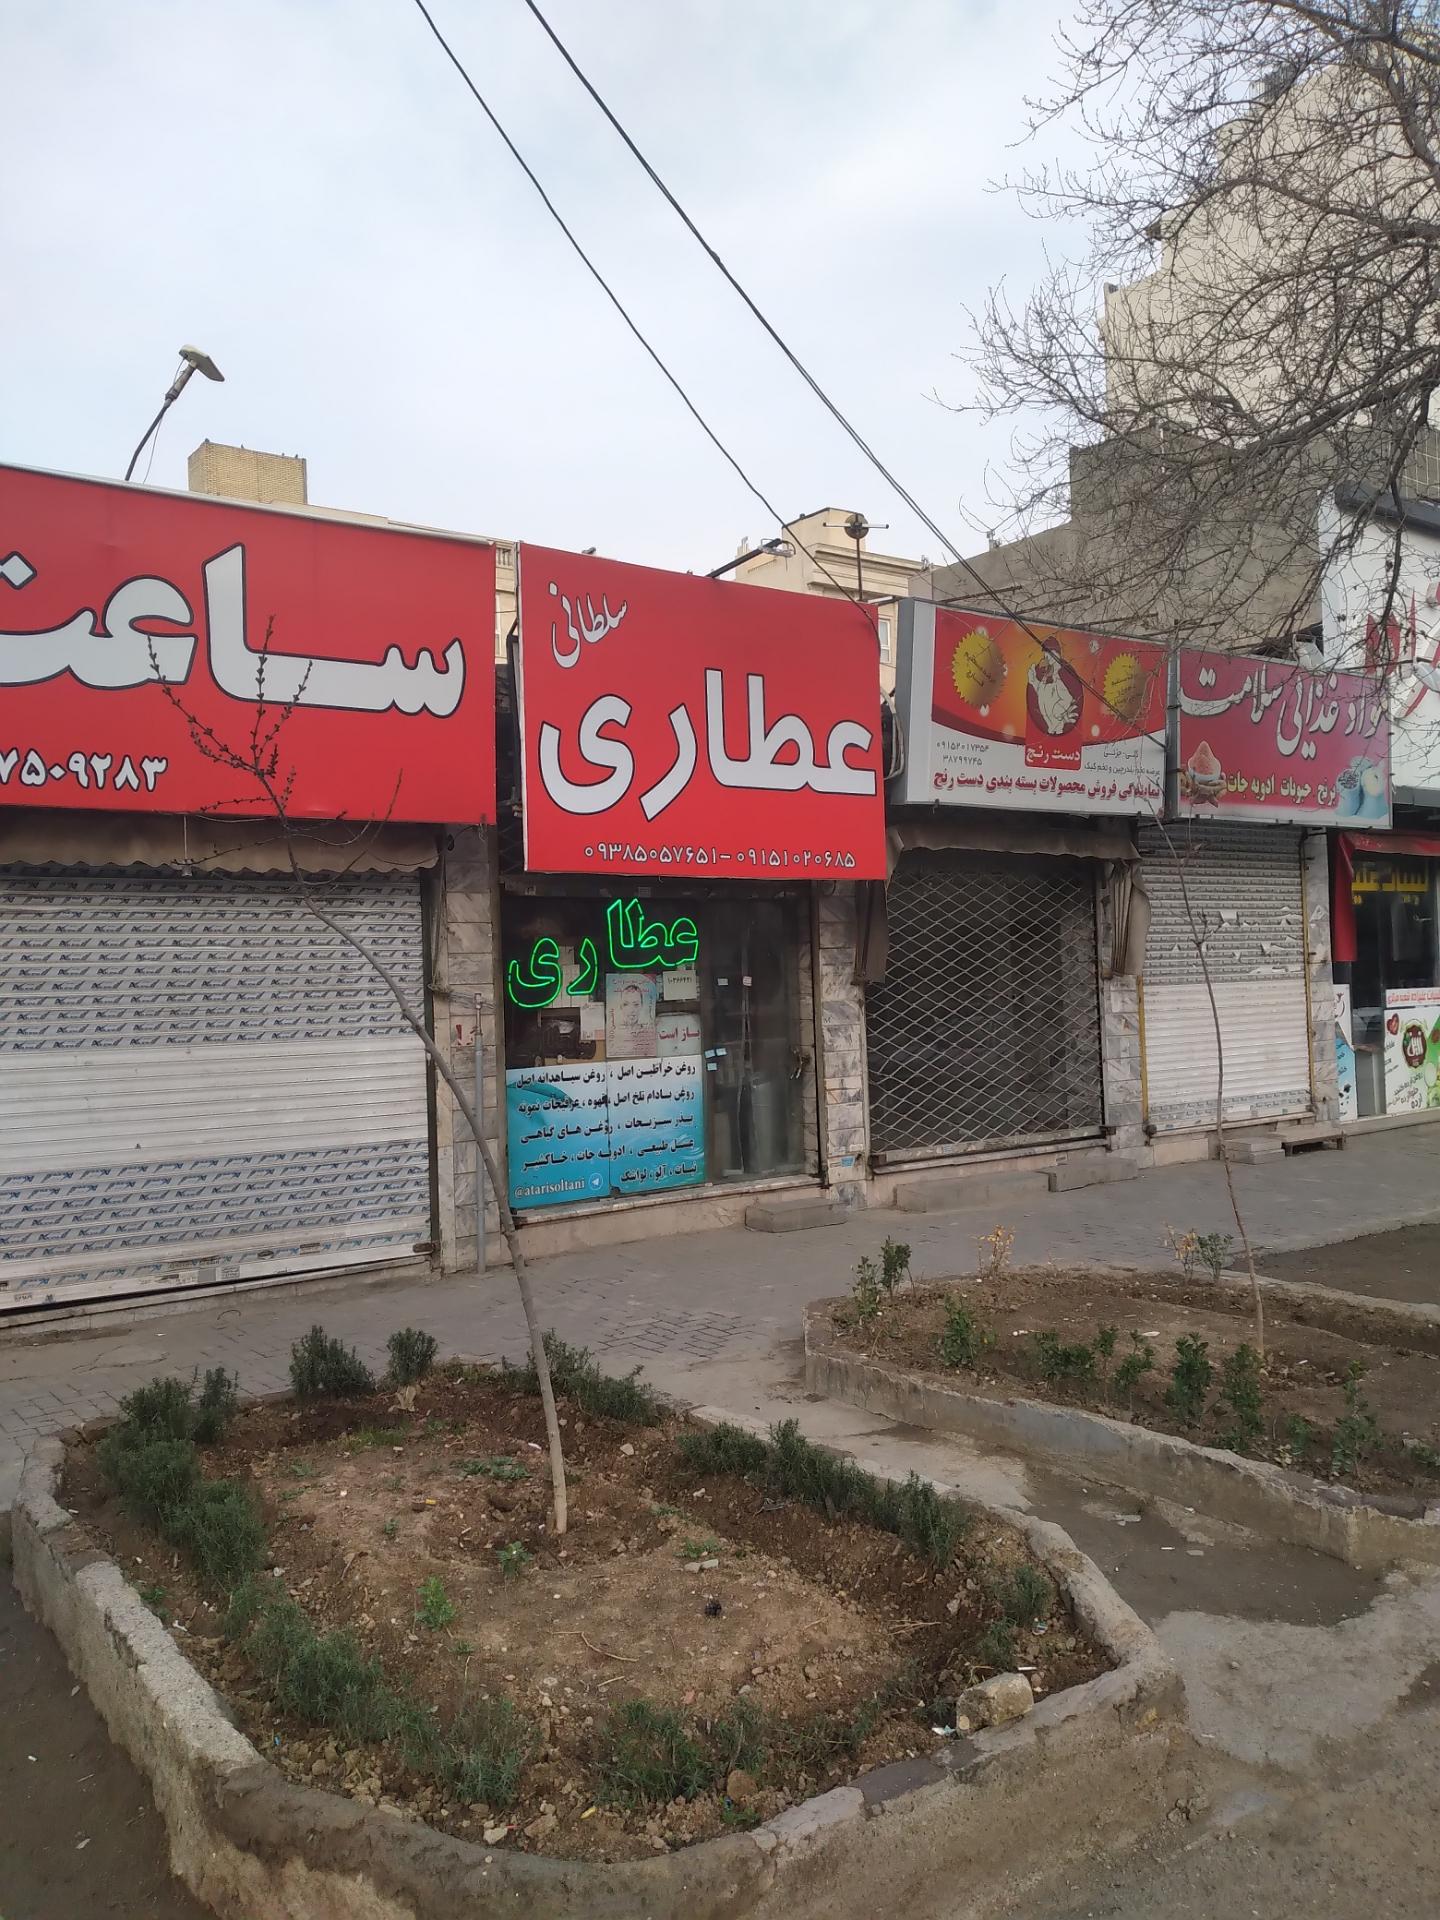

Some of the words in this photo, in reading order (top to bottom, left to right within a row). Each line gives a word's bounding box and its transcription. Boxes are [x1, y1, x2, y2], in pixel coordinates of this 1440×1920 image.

[549, 581, 628, 669] سلطانی
[1178, 663, 1284, 724] سلامت
[538, 667, 877, 823] عطاری
[1026, 745, 1050, 764] رنج
[1052, 747, 1081, 763] دست
[933, 768, 953, 790] رنج
[957, 771, 984, 789] دست
[986, 774, 1012, 794] بندی
[1015, 775, 1037, 795] بسته
[1039, 776, 1086, 796] محصولات
[1226, 770, 1249, 799] جات
[1251, 774, 1275, 801] ادویه
[1087, 779, 1117, 800] فروش
[1280, 776, 1311, 802] حبوبات
[1317, 777, 1336, 806] برنج
[508, 897, 700, 1009] عطاری
[658, 1027, 678, 1040] است
[680, 1026, 701, 1041] باز
[583, 1068, 606, 1084] روغن
[617, 1065, 634, 1080] اصل
[636, 1062, 673, 1079] خراطین
[675, 1061, 696, 1075] روغن
[516, 1073, 535, 1089] اصل
[537, 1070, 581, 1085] سیاهدانه
[613, 1092, 630, 1107] اصل
[632, 1090, 645, 1105] تلخ
[646, 1088, 672, 1104] بادام
[674, 1088, 695, 1102] روغن
[518, 1102, 541, 1116] نمونه
[557, 1123, 582, 1140] های
[584, 1119, 613, 1137] روغن
[624, 1116, 672, 1130] سبزیجات
[520, 1125, 555, 1144] گیاهی
[637, 1140, 669, 1157] طبیعی
[670, 1139, 694, 1153] عسل
[521, 1150, 569, 1172] خاکشیر
[576, 1148, 595, 1163] جات
[620, 1168, 647, 1184] لواشک
[655, 1163, 666, 1181] آلو
[674, 1160, 697, 1176] نبات
[514, 1177, 586, 1199] @atarisoltani
